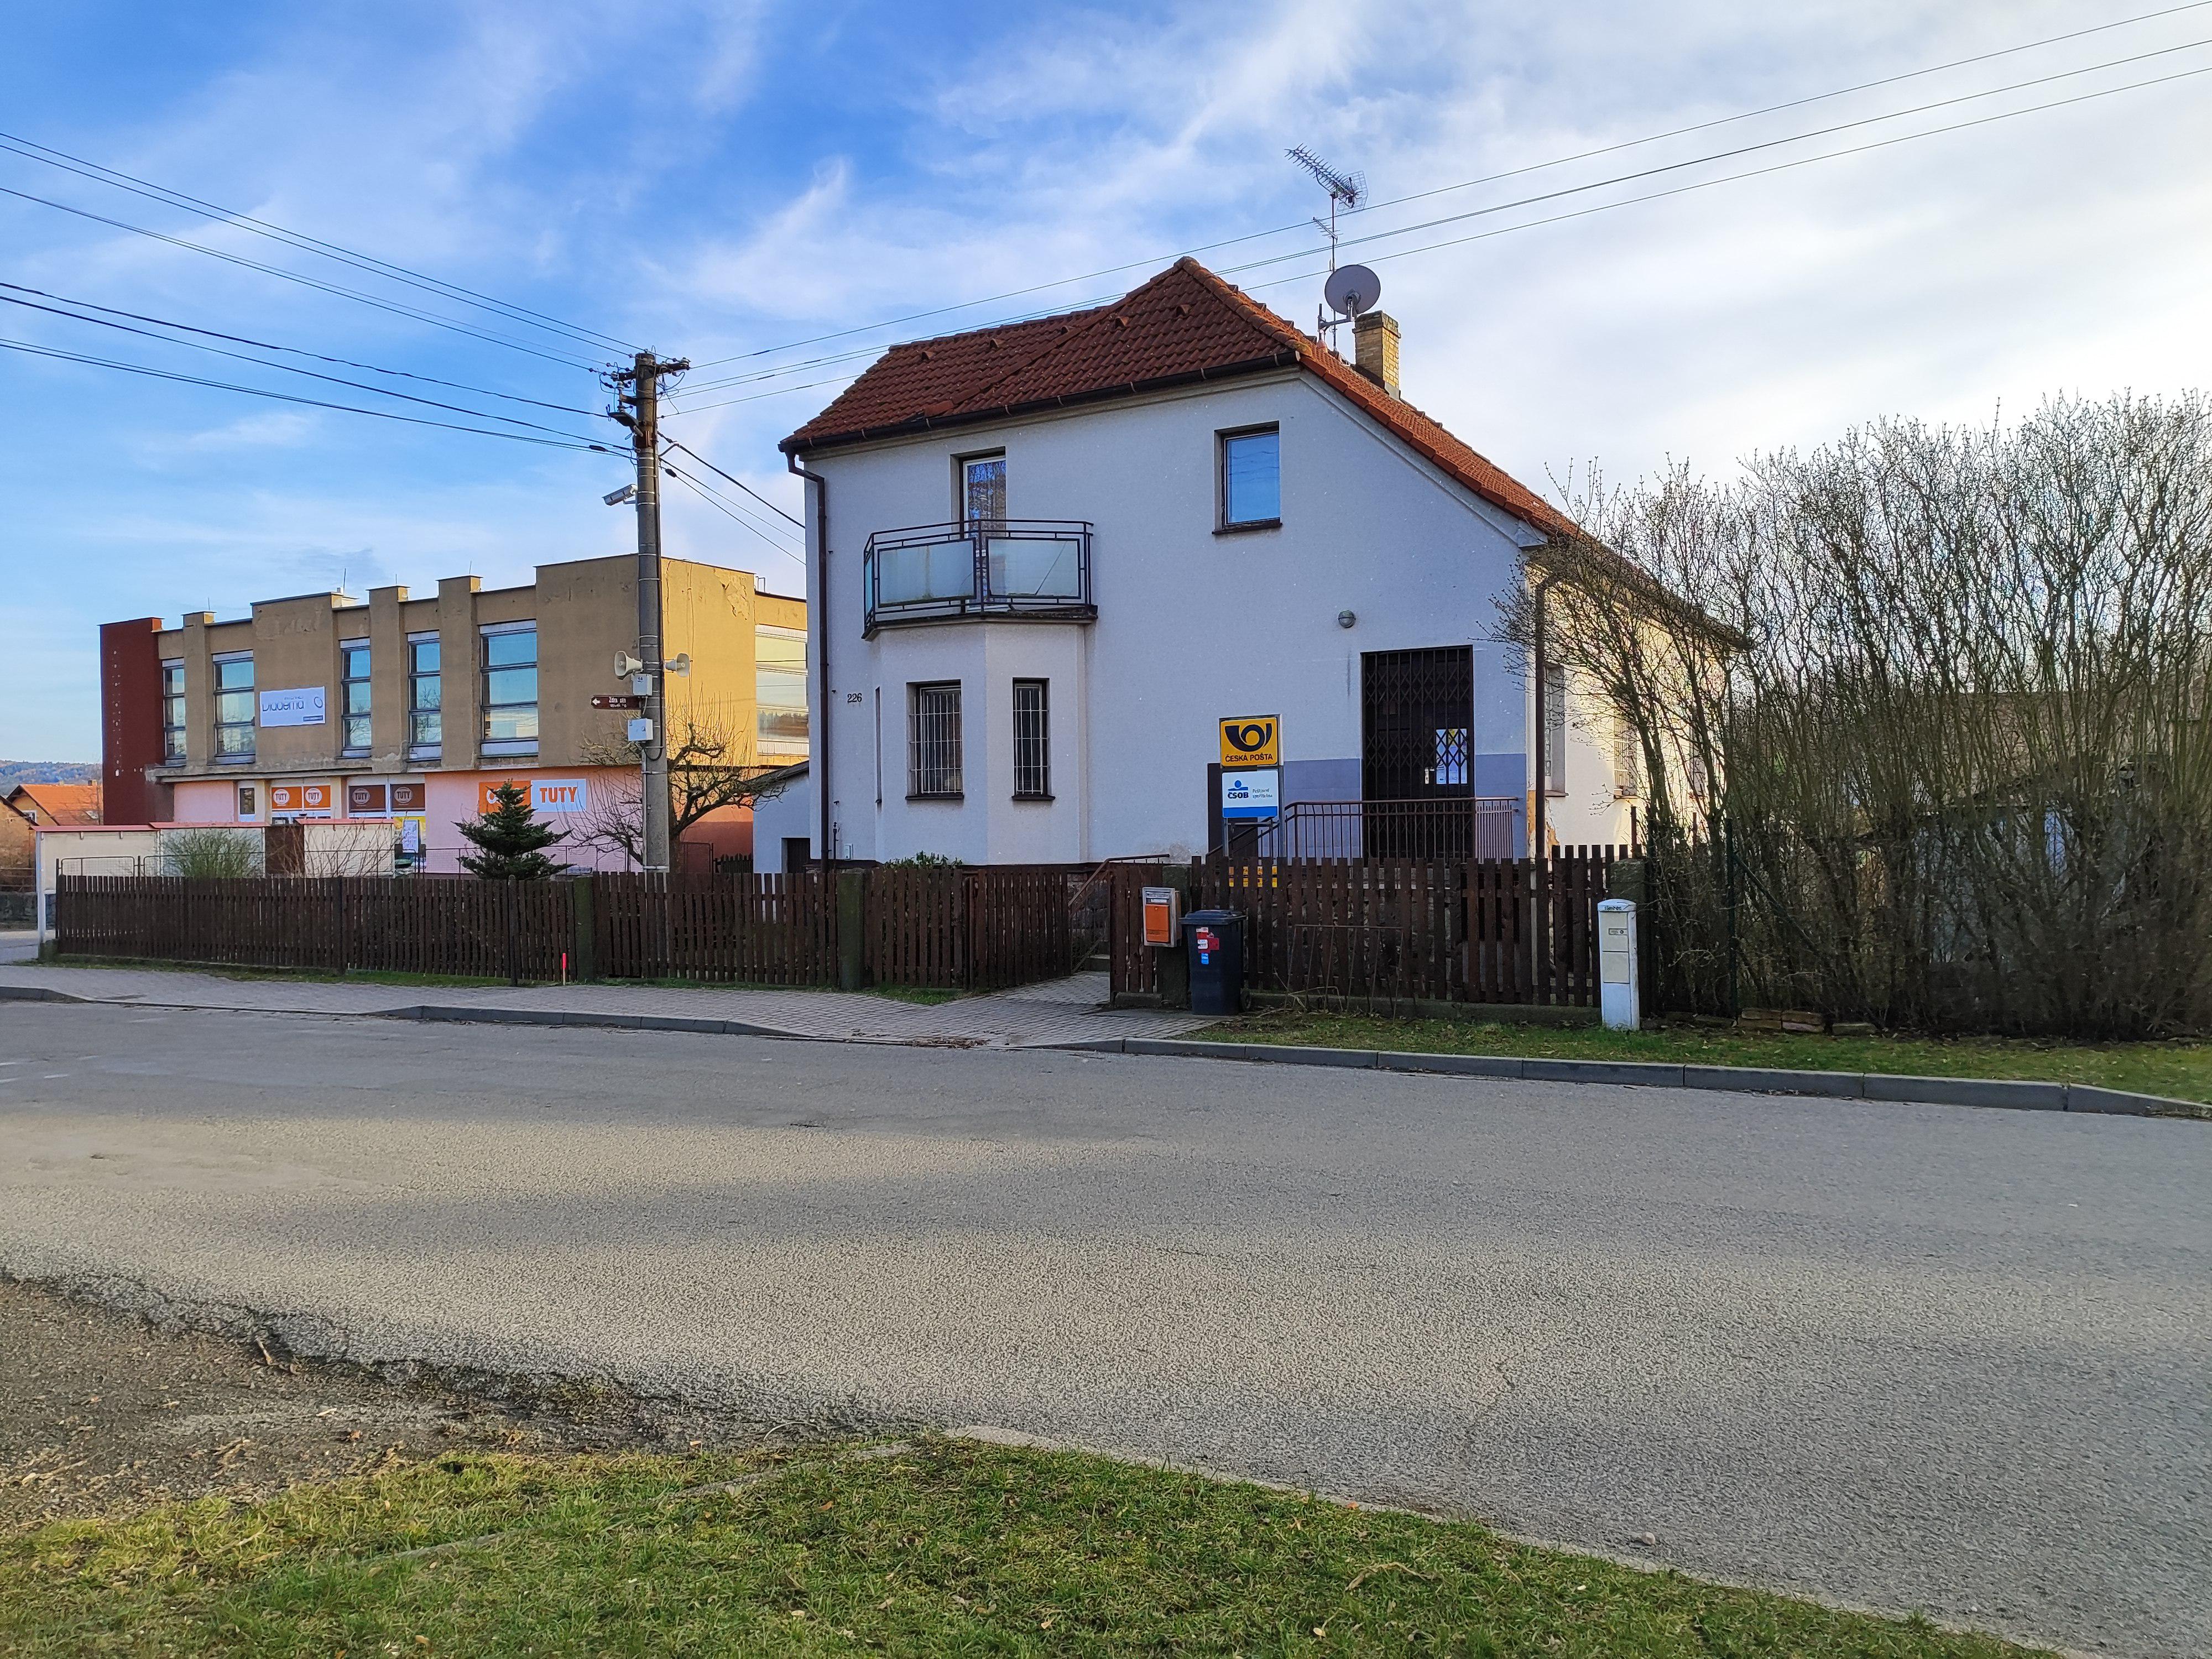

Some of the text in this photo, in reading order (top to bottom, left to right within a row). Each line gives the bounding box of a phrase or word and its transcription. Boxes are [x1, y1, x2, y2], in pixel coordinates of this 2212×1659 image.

[847, 692, 862, 703] 226
[1225, 753, 1274, 762] ČESKÁ POŠTA
[397, 791, 410, 799] TUTY
[539, 787, 577, 803] TUTY
